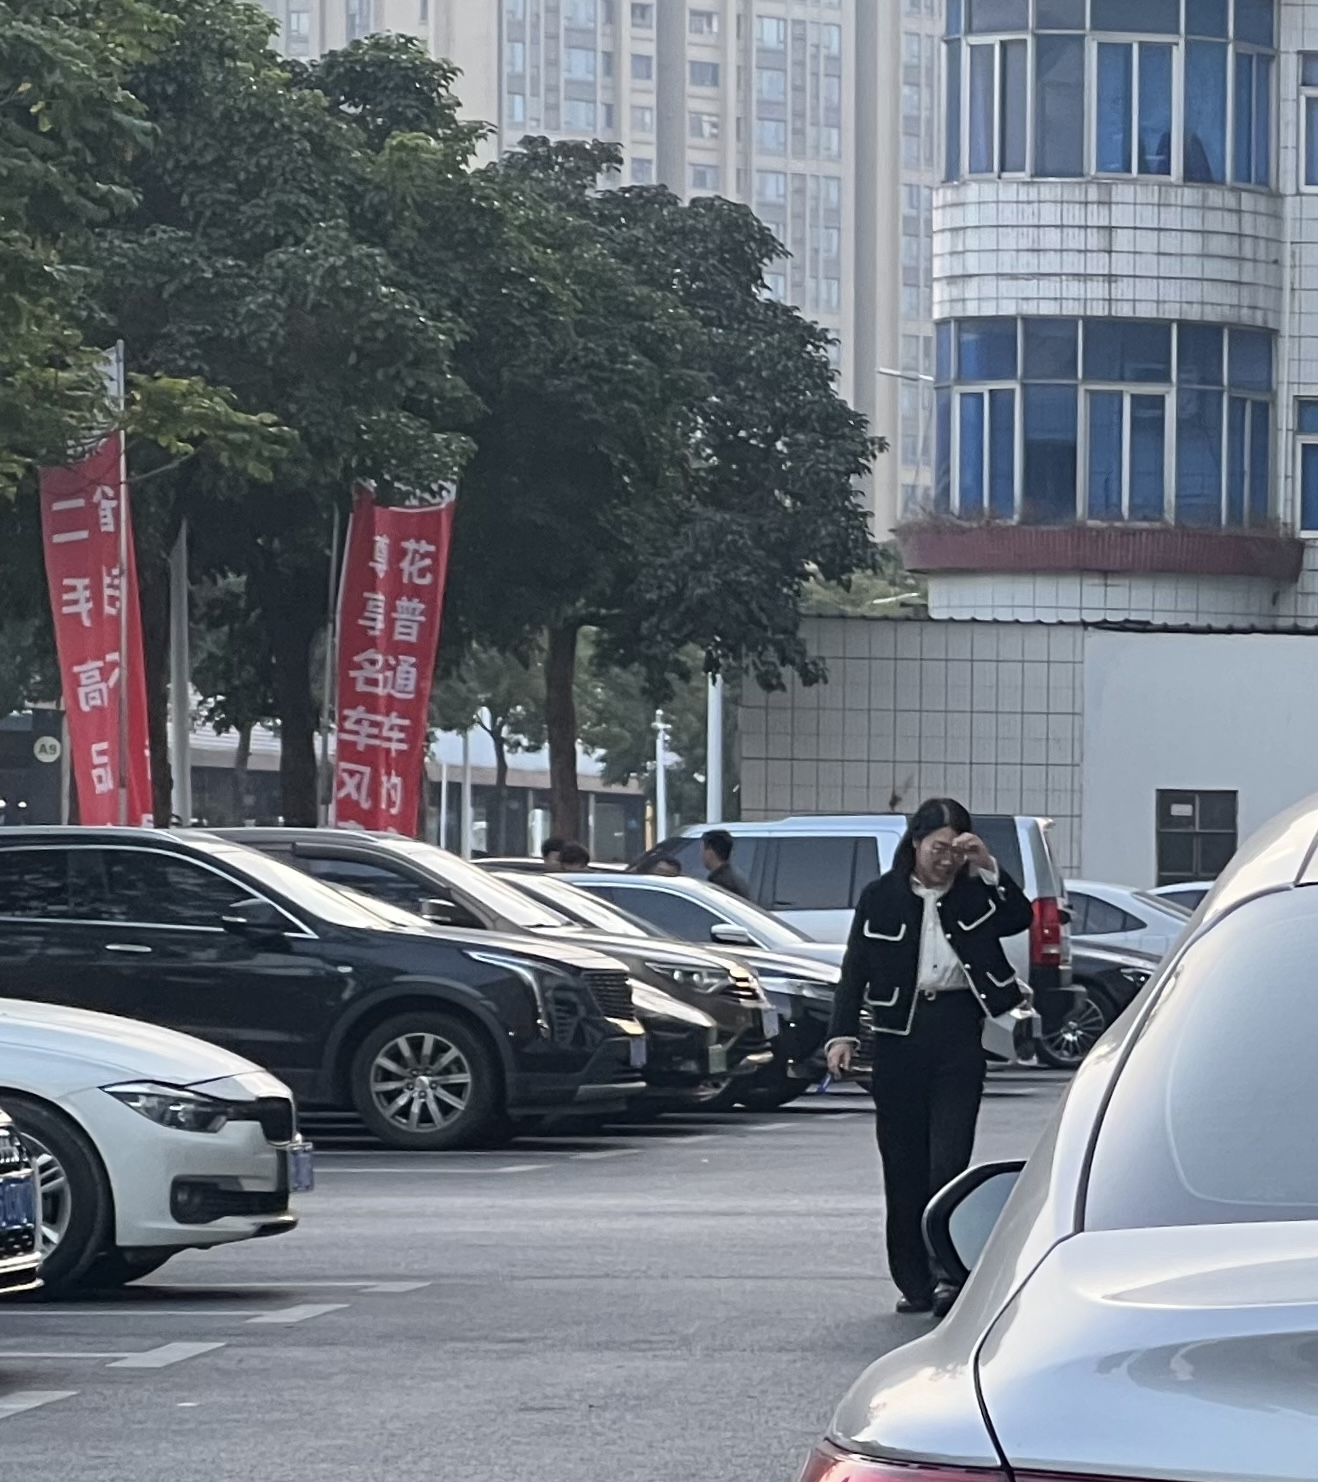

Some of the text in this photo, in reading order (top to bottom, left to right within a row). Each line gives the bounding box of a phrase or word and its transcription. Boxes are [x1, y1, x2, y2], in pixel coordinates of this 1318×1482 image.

[337, 533, 391, 830] 尊享名车风
[380, 538, 437, 834] 花普通车的
